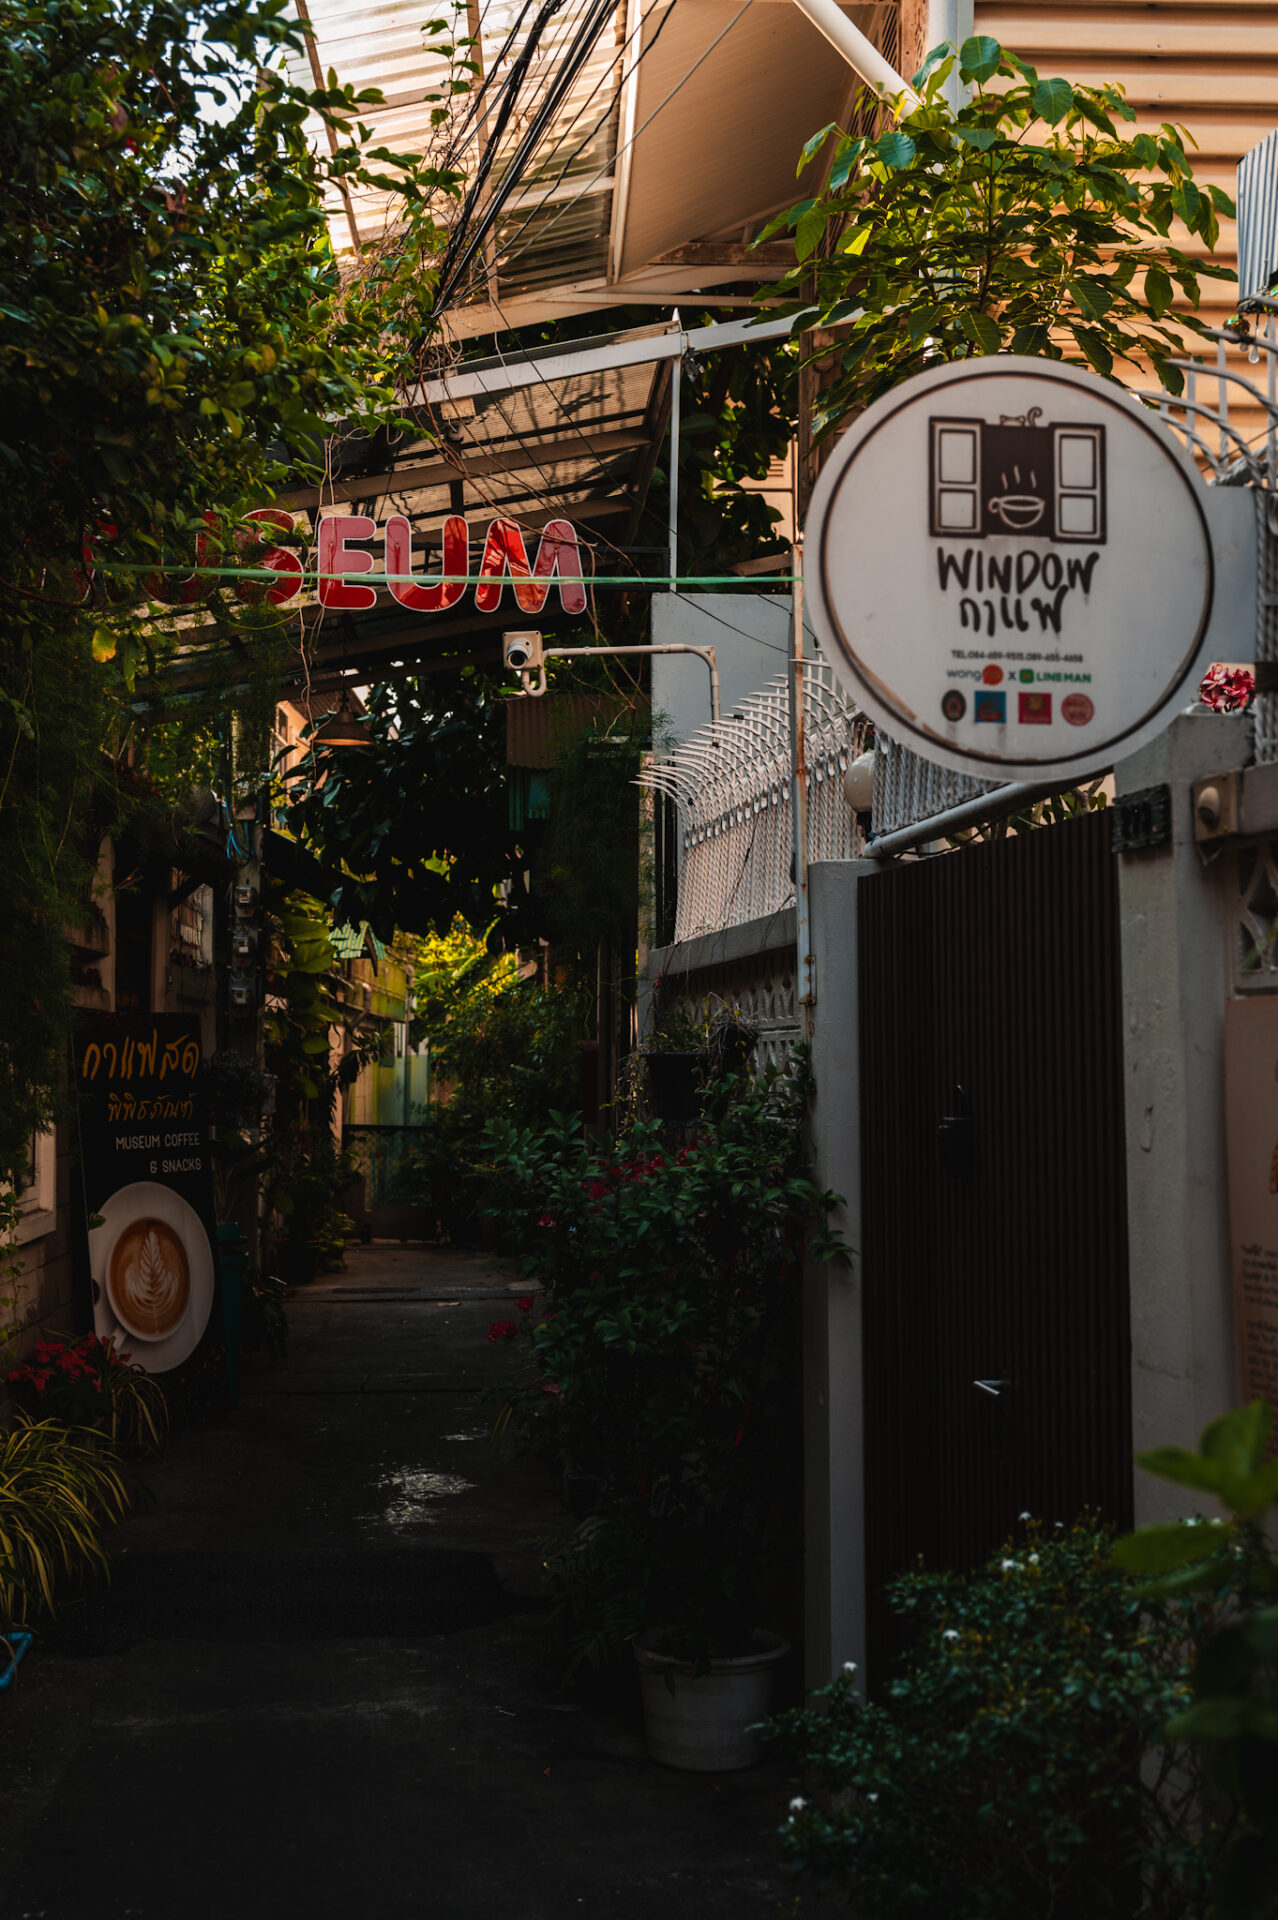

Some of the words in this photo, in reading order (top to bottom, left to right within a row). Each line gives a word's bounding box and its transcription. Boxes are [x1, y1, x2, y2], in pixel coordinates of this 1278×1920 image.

[937, 546, 1100, 594] WINDOW
[959, 584, 1070, 637] กาแฟ
[81, 1027, 200, 1080] กาแฟสด
[115, 1134, 161, 1151] MUSEUM
[164, 1132, 201, 1147] COFFEE
[162, 1157, 203, 1174] SNACKS
